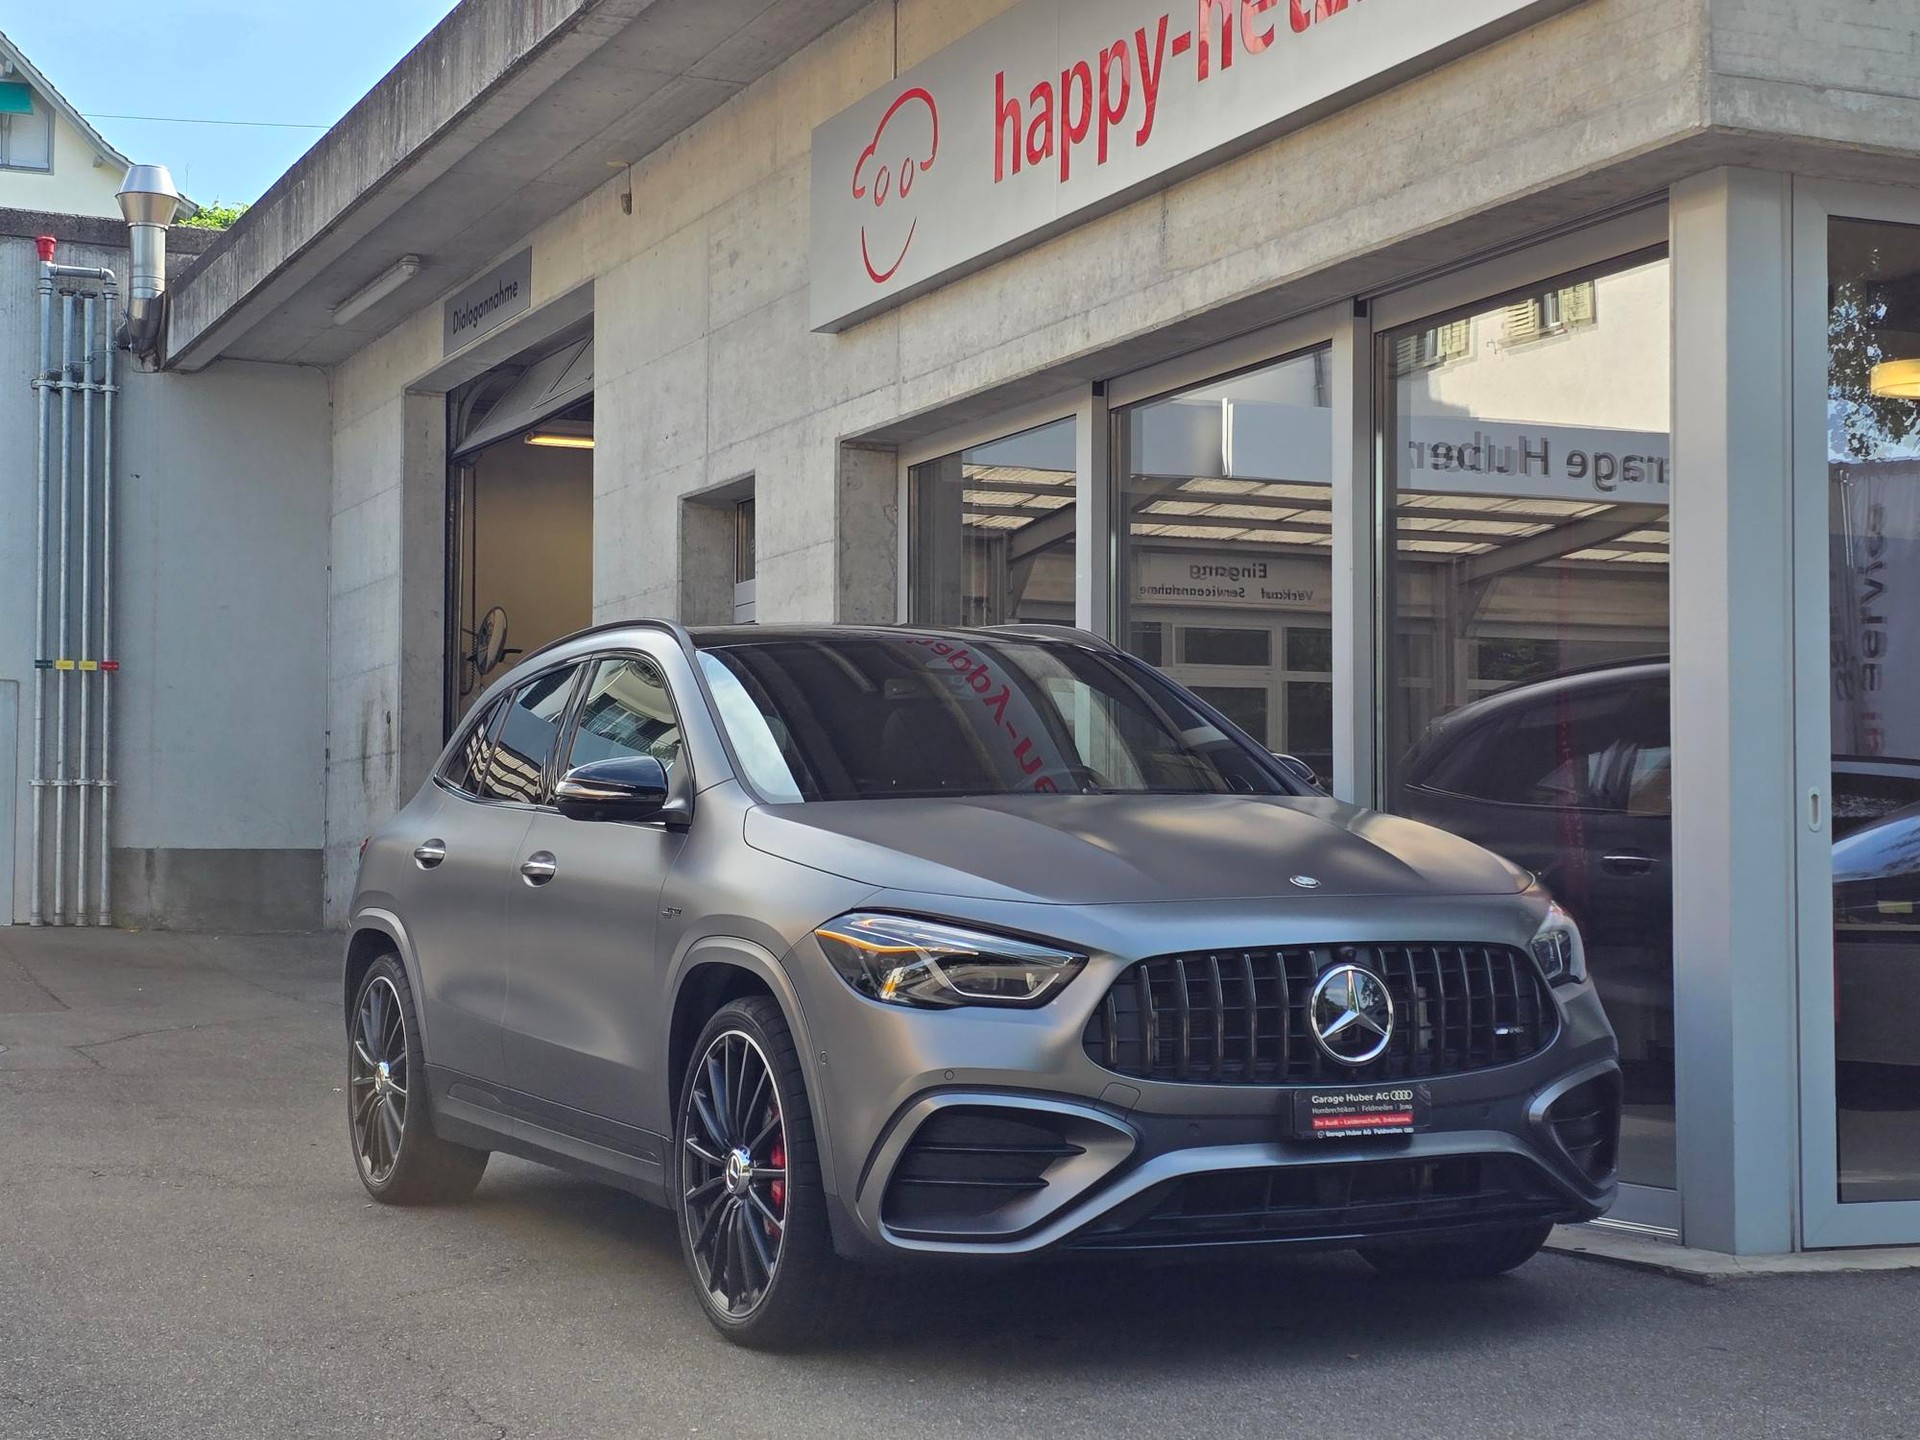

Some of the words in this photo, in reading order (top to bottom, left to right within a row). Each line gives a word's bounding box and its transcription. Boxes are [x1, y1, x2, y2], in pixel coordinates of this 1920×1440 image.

[995, 0, 1362, 183] happy-ne
[453, 280, 518, 334] Dialogannahme
[1311, 1095, 1345, 1105] Garage
[1346, 1093, 1374, 1102] Huber
[1375, 1092, 1390, 1101] AG
